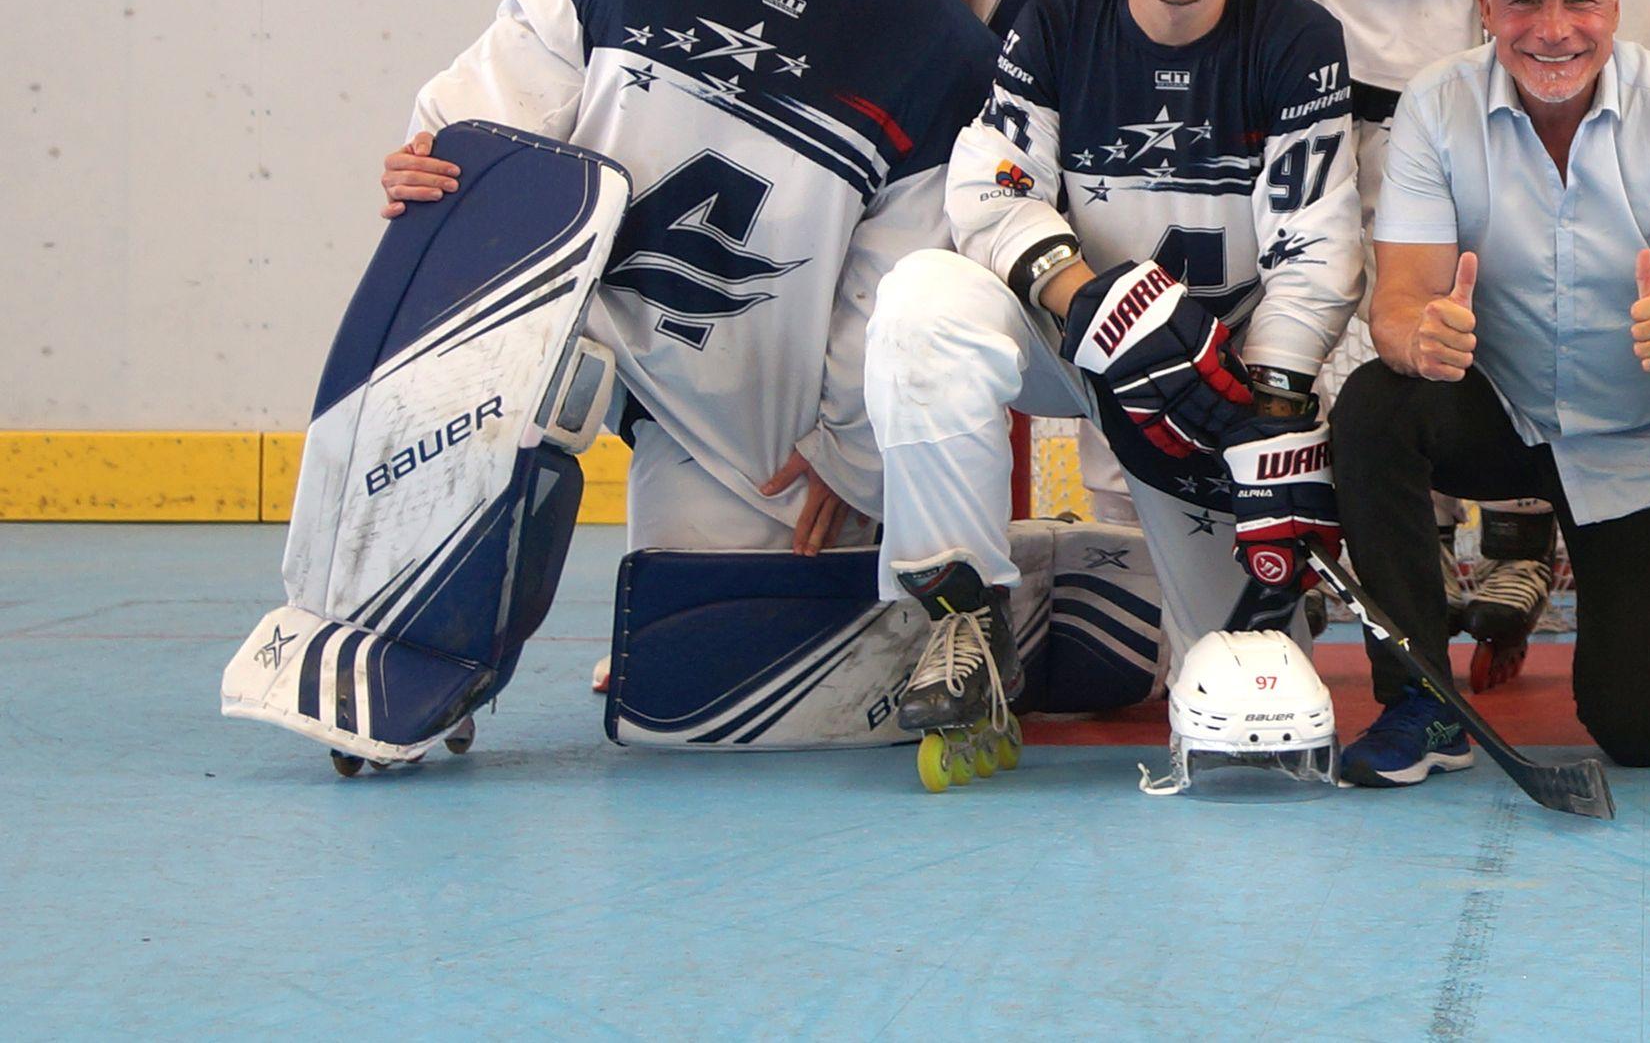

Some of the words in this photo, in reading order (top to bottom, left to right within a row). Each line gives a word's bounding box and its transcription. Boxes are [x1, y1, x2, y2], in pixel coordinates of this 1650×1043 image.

[1155, 71, 1190, 85] CIT
[1267, 131, 1345, 213] 97
[1237, 488, 1273, 498] ALPHA
[1255, 675, 1278, 690] 97
